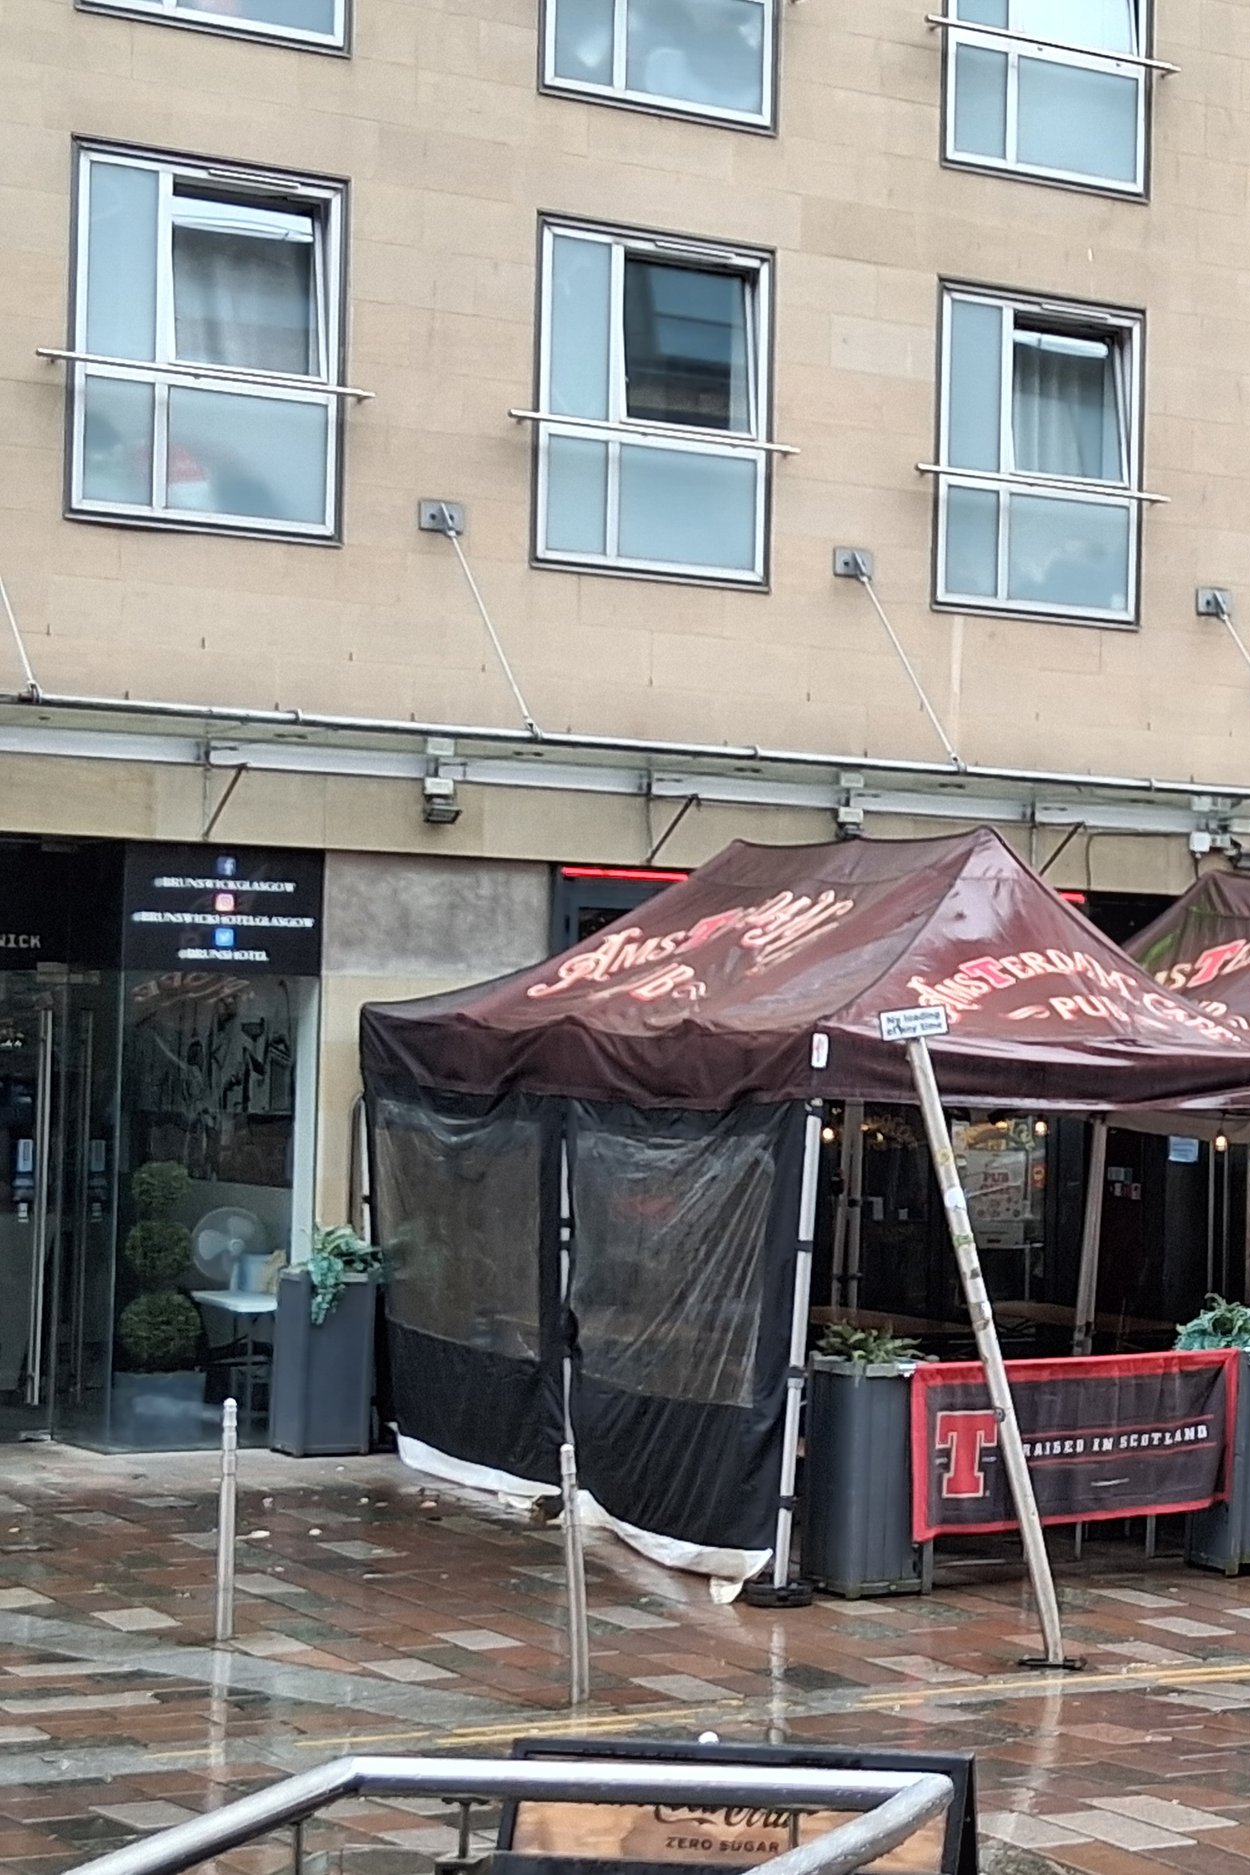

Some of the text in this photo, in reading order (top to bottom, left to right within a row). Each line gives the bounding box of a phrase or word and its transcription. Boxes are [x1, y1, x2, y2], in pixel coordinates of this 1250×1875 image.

[935, 1409, 998, 1499] T
[1022, 1423, 1208, 1458] RAISED IN SCOTLAND
[665, 1836, 780, 1854] ZERO SUGAR
